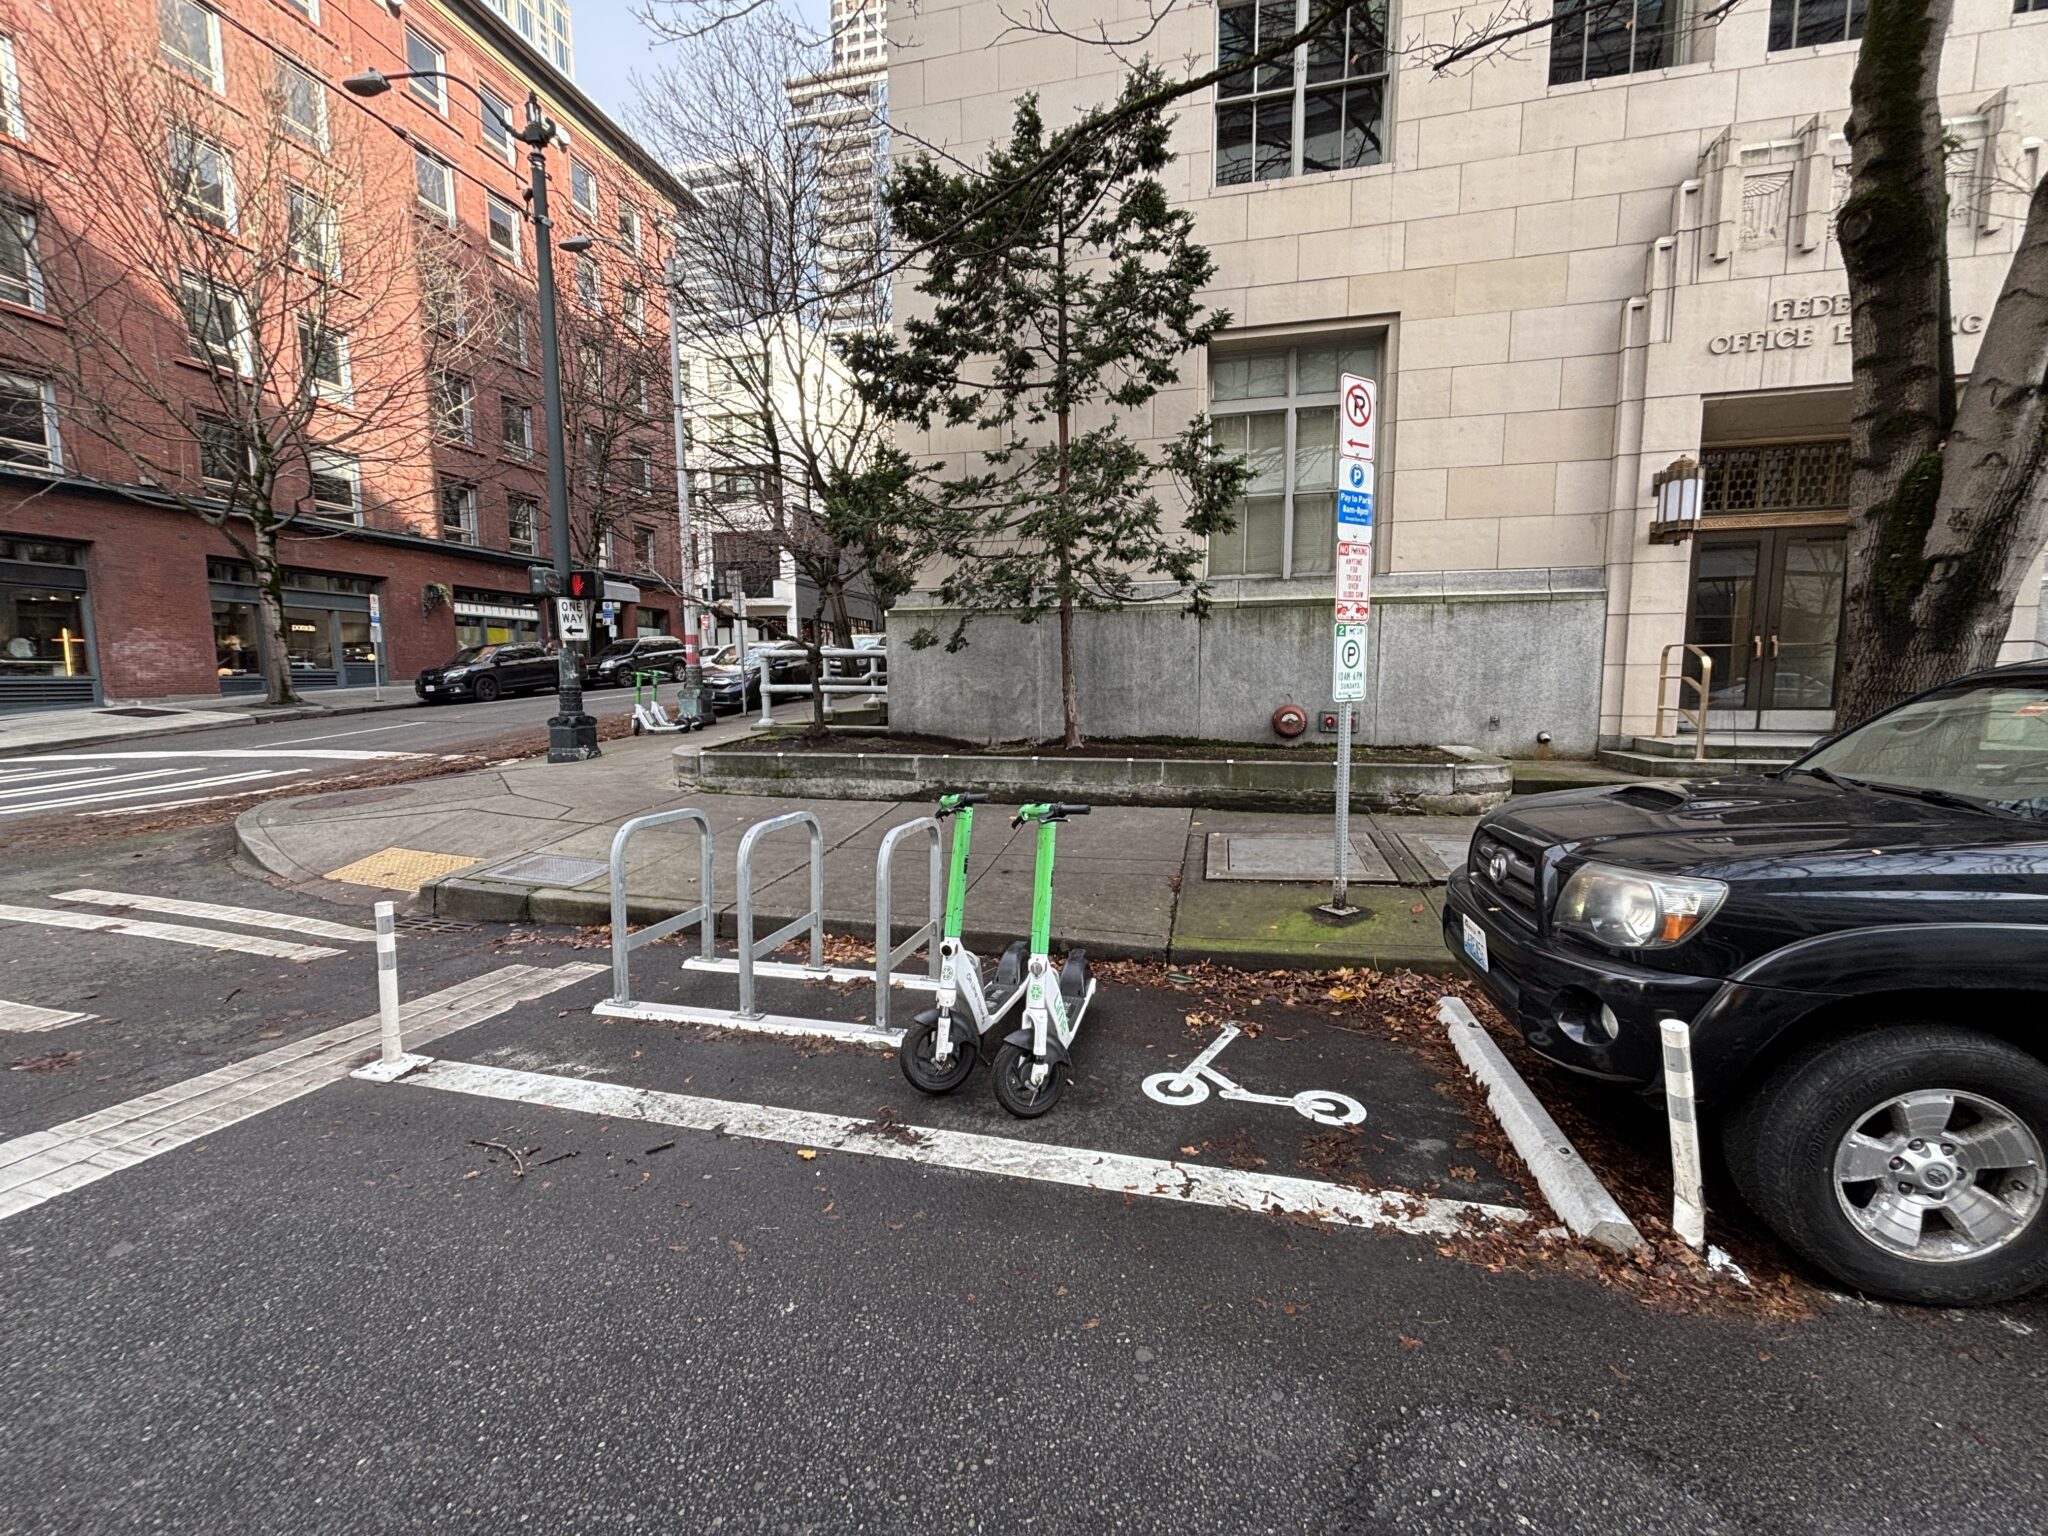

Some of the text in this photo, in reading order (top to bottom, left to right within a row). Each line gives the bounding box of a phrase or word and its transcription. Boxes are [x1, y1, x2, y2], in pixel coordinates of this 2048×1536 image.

[1774, 293, 1851, 321] FEDE
[1709, 326, 1815, 355] OFFICE
[1340, 492, 1371, 505] Pay to Park
[1339, 544, 1368, 556] NO PARKING
[1346, 558, 1363, 566] ANYTIME
[1350, 566, 1358, 574] FOR
[1346, 574, 1362, 582] TRUCKS
[1348, 582, 1359, 590] OVER
[561, 601, 583, 612] ONE
[562, 613, 583, 624] WAY
[1338, 625, 1345, 636] 2
[1347, 646, 1356, 663] P
[1340, 682, 1361, 690] SUNDAYS
